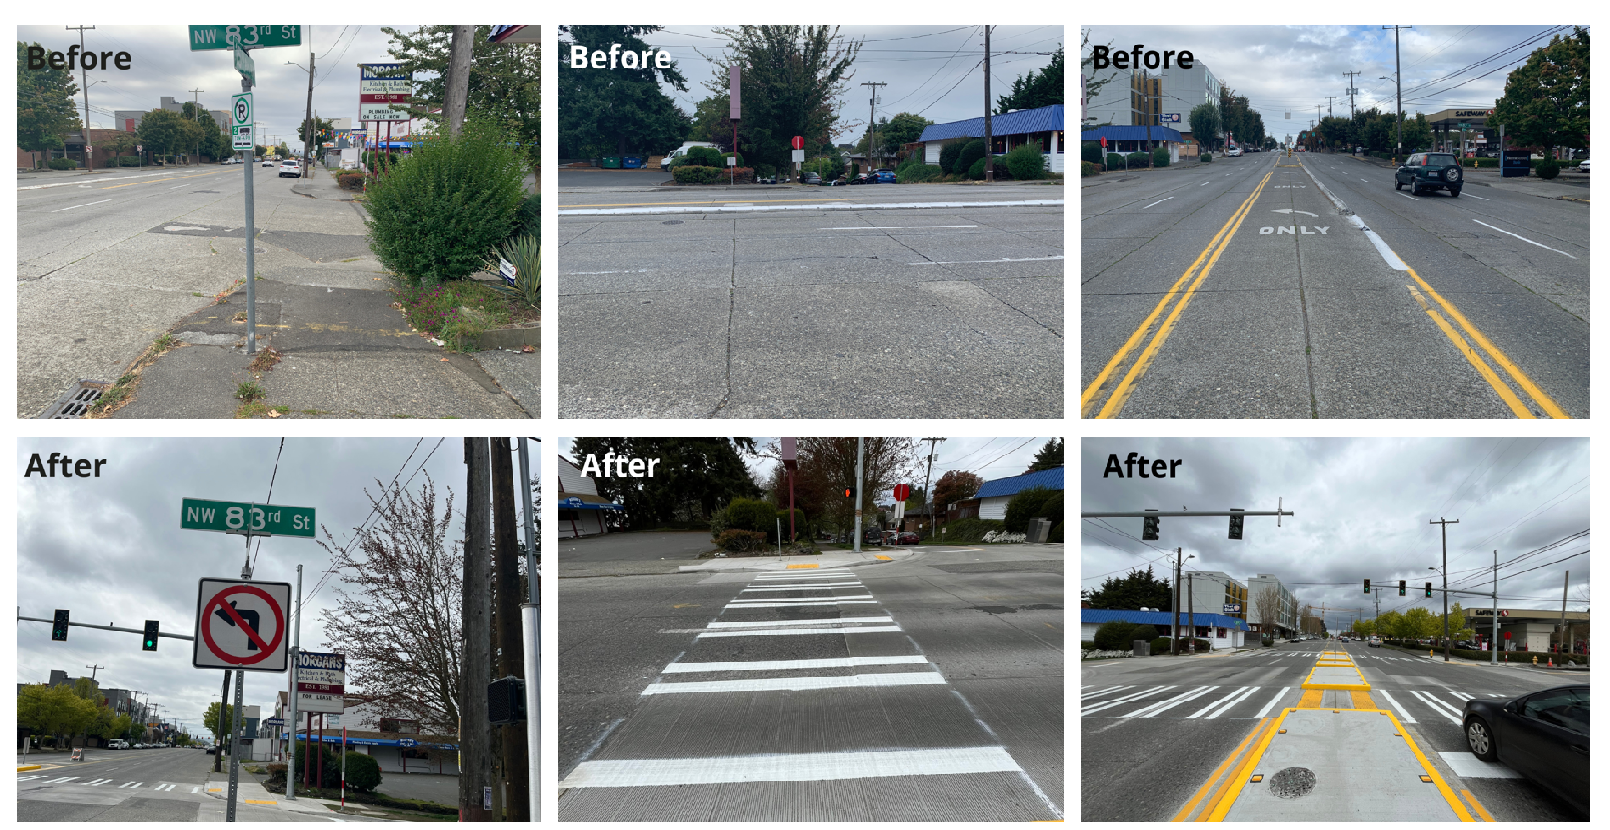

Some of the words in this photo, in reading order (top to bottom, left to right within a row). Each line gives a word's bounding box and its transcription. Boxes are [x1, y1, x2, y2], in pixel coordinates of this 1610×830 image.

[194, 29, 217, 44] NW
[225, 25, 272, 45] 83rd
[281, 25, 296, 39] St
[1258, 225, 1331, 235] ONLY
[186, 506, 216, 524] NW
[225, 506, 281, 530] 83rd
[292, 514, 310, 530] St
